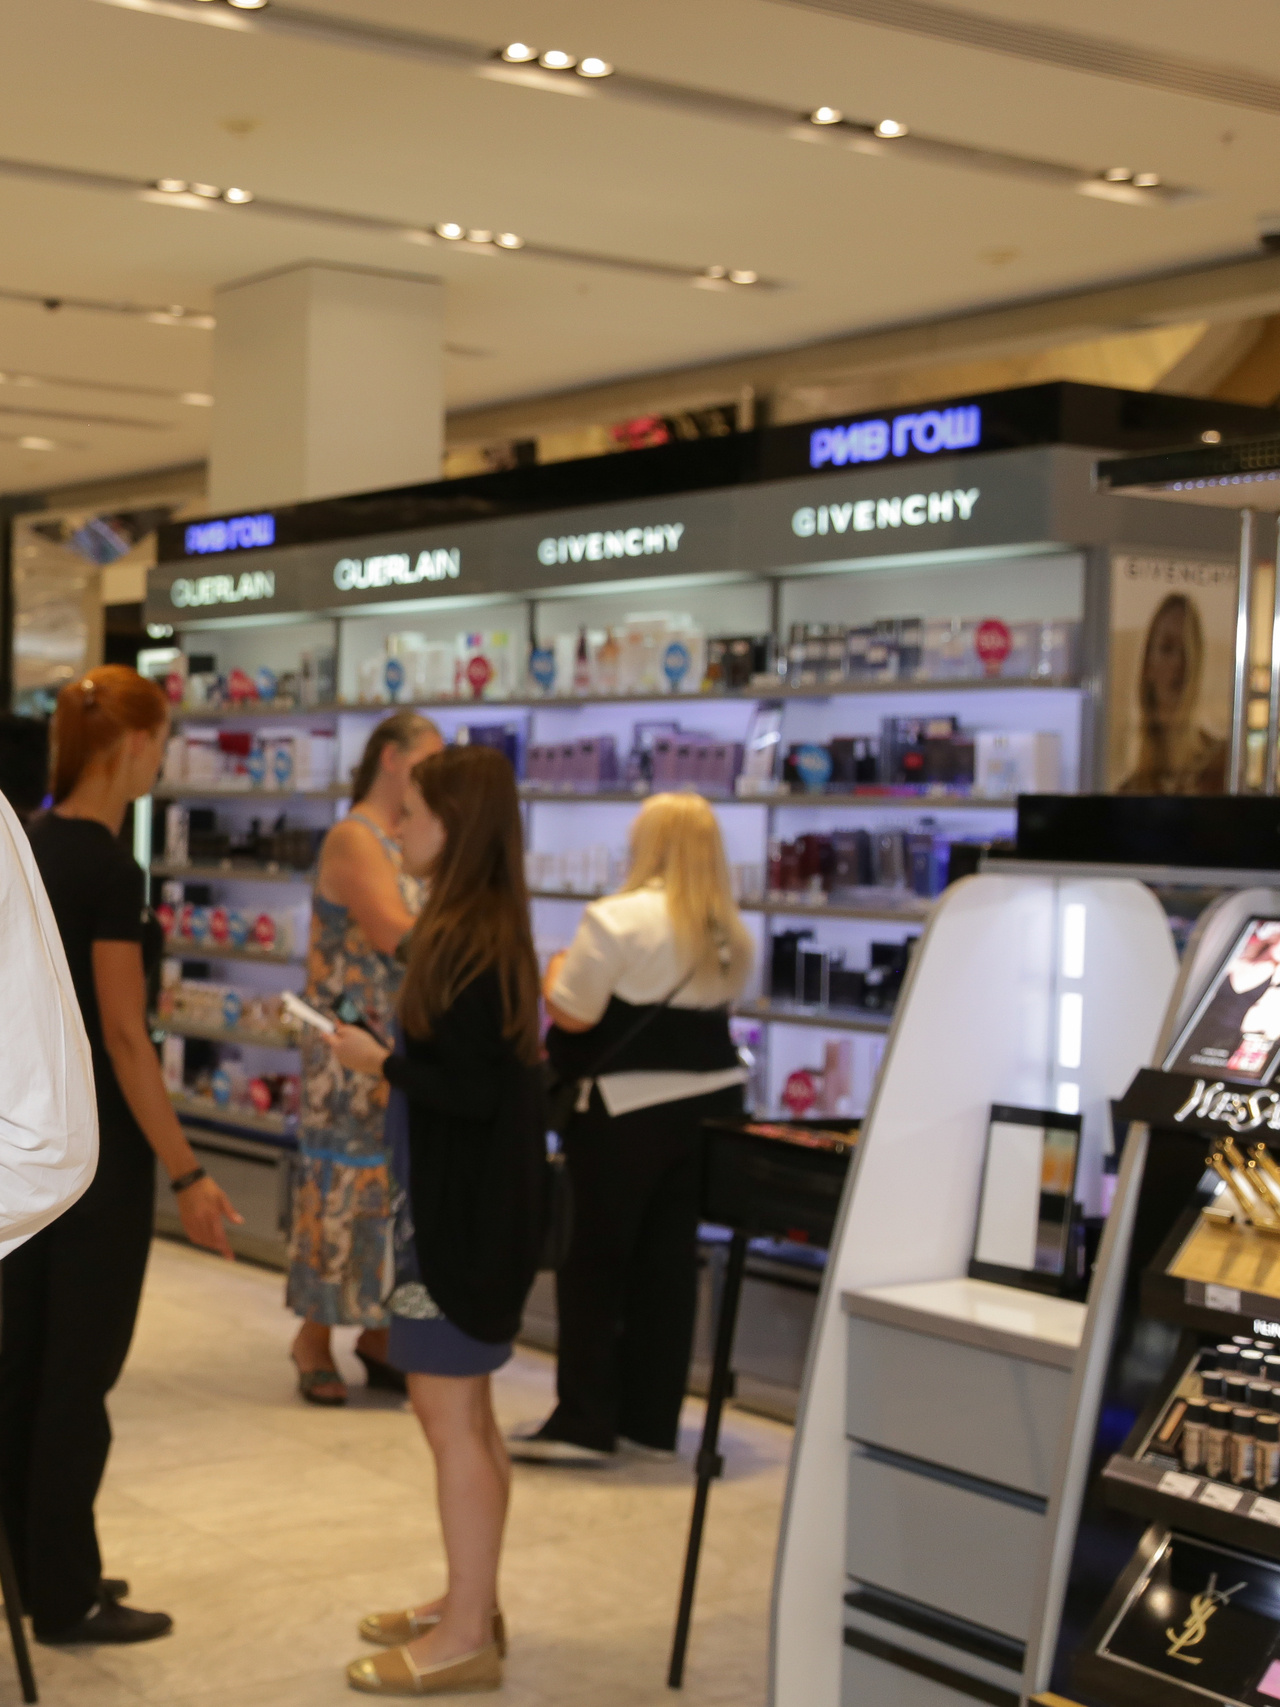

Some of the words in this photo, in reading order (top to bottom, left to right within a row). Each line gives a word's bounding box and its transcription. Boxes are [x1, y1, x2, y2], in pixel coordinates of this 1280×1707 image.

[810, 419, 890, 468] РИВ
[892, 404, 982, 457] ГОШ
[791, 487, 981, 538] GIVENCHY
[537, 521, 685, 566] GIVENCHY
